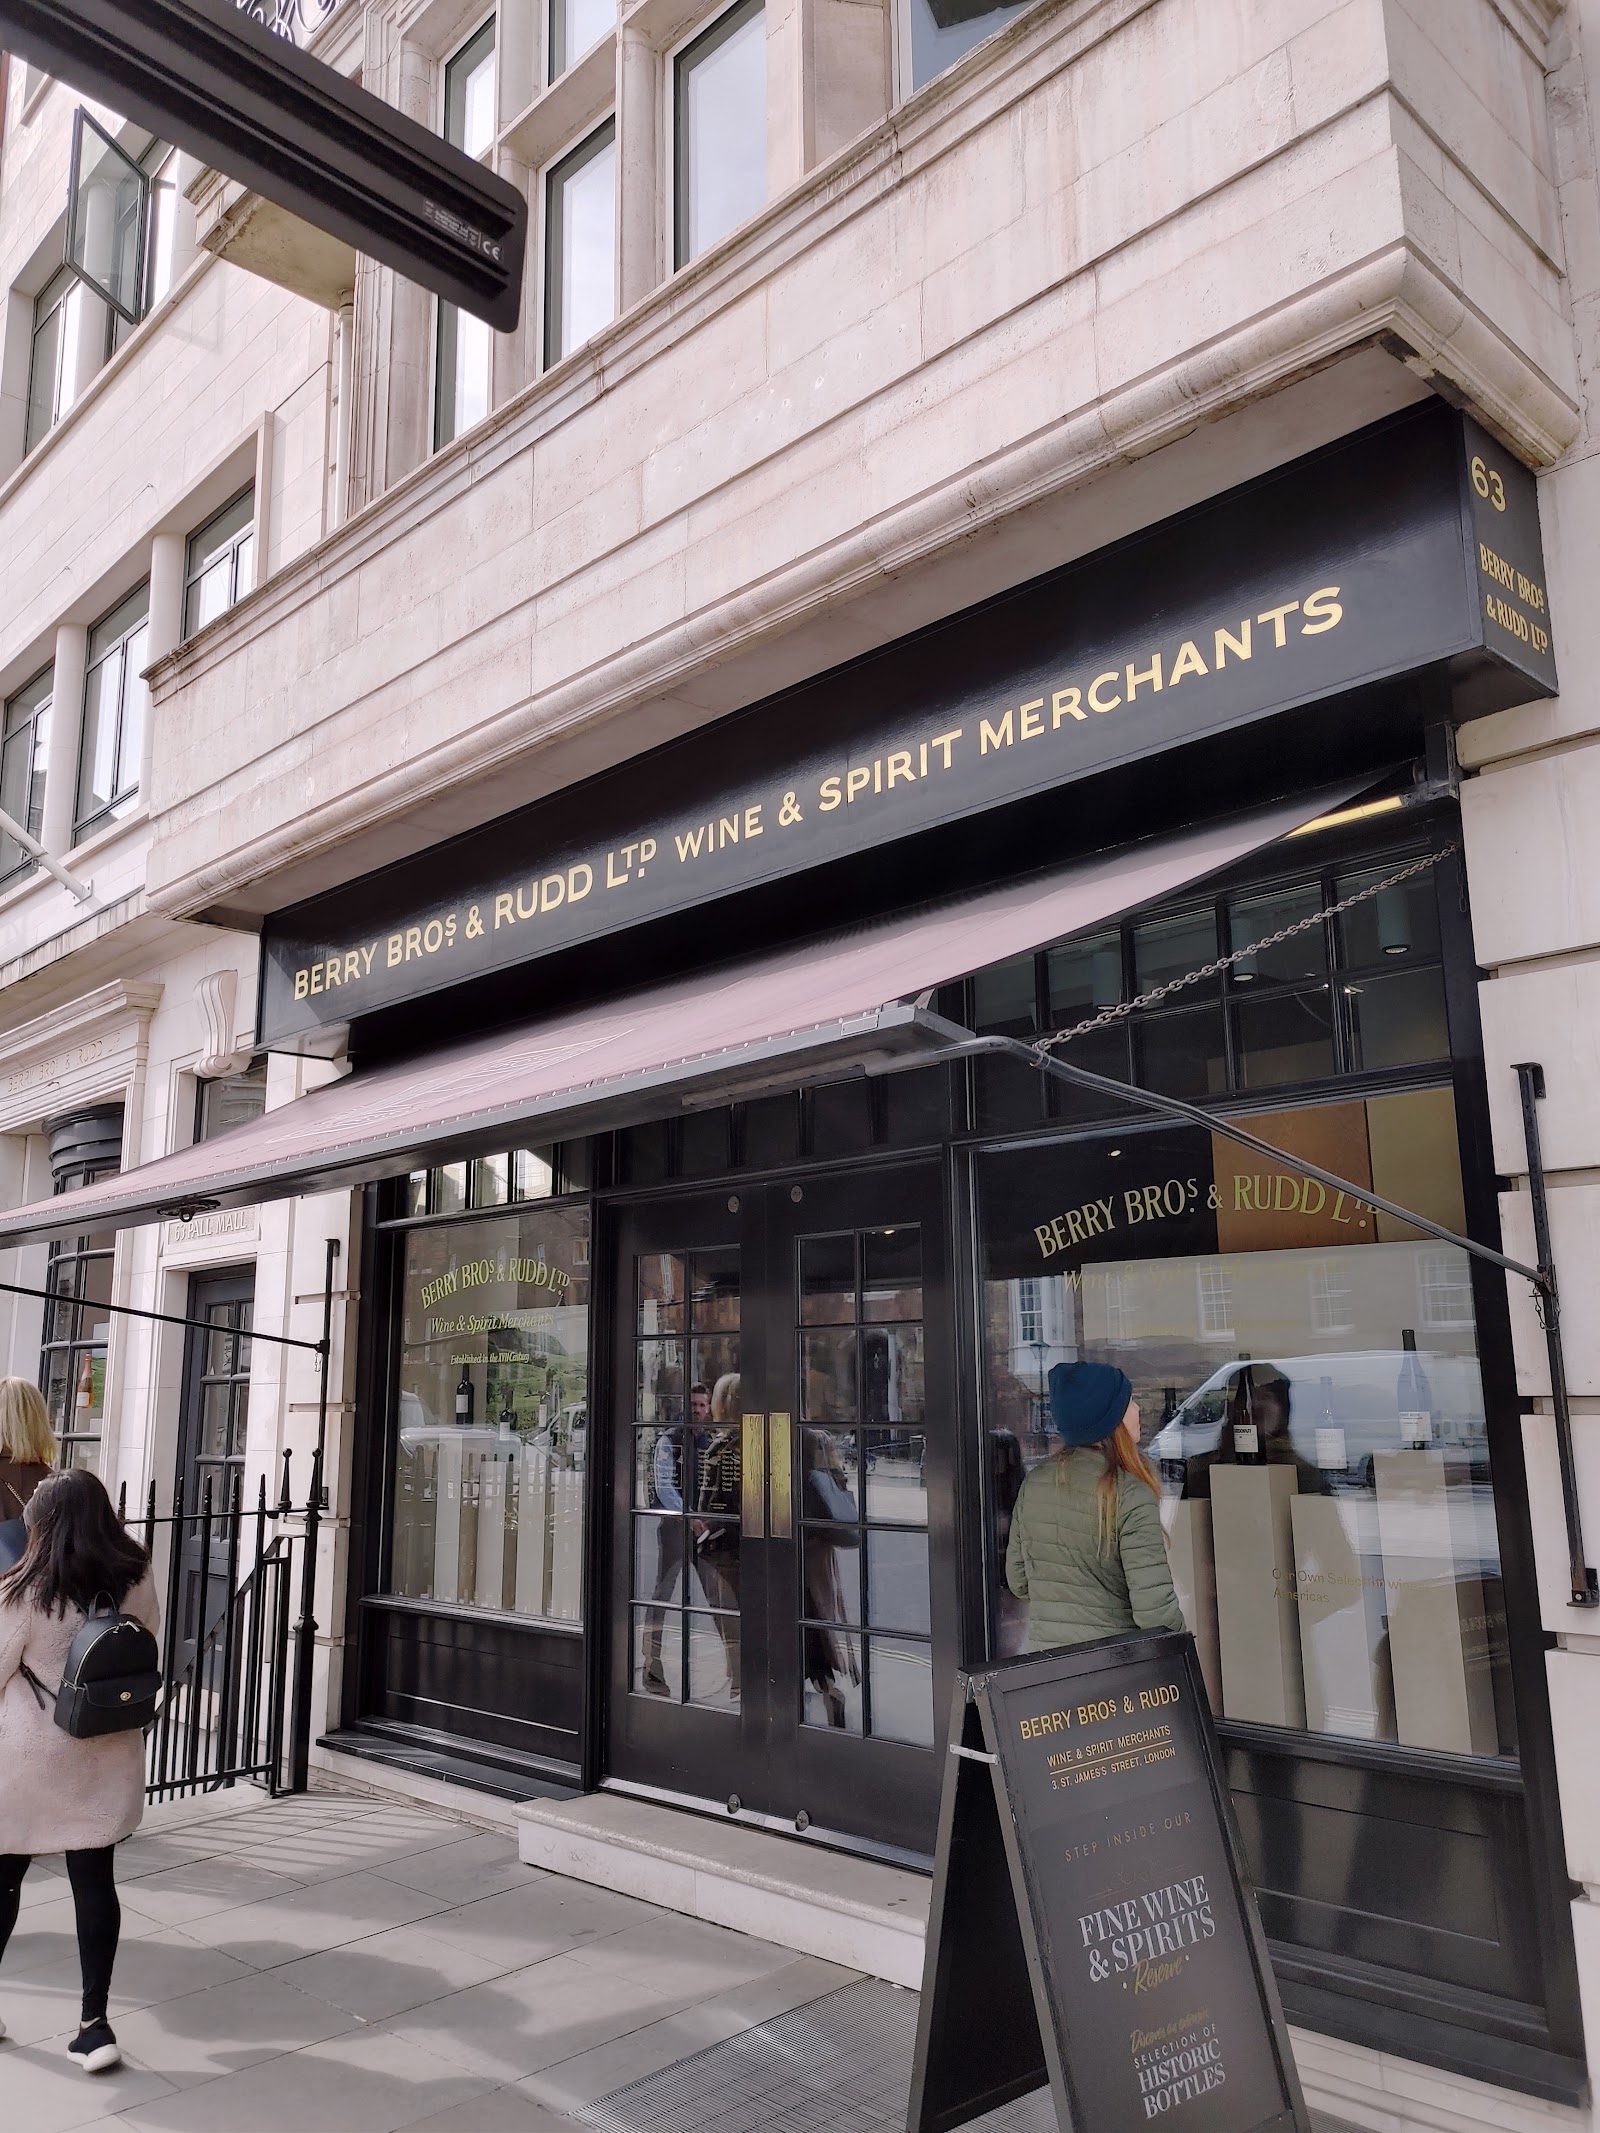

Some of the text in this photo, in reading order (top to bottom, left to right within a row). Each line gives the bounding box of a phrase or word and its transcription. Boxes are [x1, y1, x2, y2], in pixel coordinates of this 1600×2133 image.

[1471, 456, 1506, 512] 63
[1479, 542, 1516, 592] BERRY
[1486, 593, 1498, 622] &
[1496, 598, 1529, 642] RUDD
[294, 943, 377, 1001] BERRY
[465, 905, 485, 939] &
[494, 863, 593, 929] RUDD
[674, 804, 764, 863] WINE
[777, 791, 804, 827] &
[818, 728, 963, 812] SPIRIT
[979, 585, 1343, 755] MERCHANTS
[187, 1218, 213, 1239] PALL
[216, 1211, 248, 1234] MALL
[1034, 1195, 1116, 1259] BERRY
[1206, 1184, 1224, 1210] &
[1233, 1174, 1326, 1215] RUDD
[420, 1268, 459, 1310] BERRY
[508, 1257, 548, 1286] RUDD
[431, 1317, 455, 1333] Wine
[456, 1314, 466, 1330] &
[467, 1312, 498, 1335] Spirit
[1298, 1570, 1325, 1583] Own
[1020, 1709, 1072, 1740] BERRY
[1123, 1695, 1134, 1714] &
[1139, 1684, 1180, 1710] RUDD
[1047, 1725, 1171, 1767] WINE & SPIRIT MERCHANTS
[1060, 1776, 1073, 1788] ST.
[1144, 1747, 1176, 1764] LONDON
[1065, 1811, 1192, 1862] STEP INSIDE OUR
[1078, 1875, 1210, 1948] FINE WINE
[1088, 1904, 1216, 1983] & SPIRITS
[1132, 1957, 1184, 1995] Reserve
[1133, 2023, 1216, 2069] SELECTION OF
[1137, 2037, 1221, 2094] HISTORIC
[1142, 2062, 1226, 2120] BOTTLES
